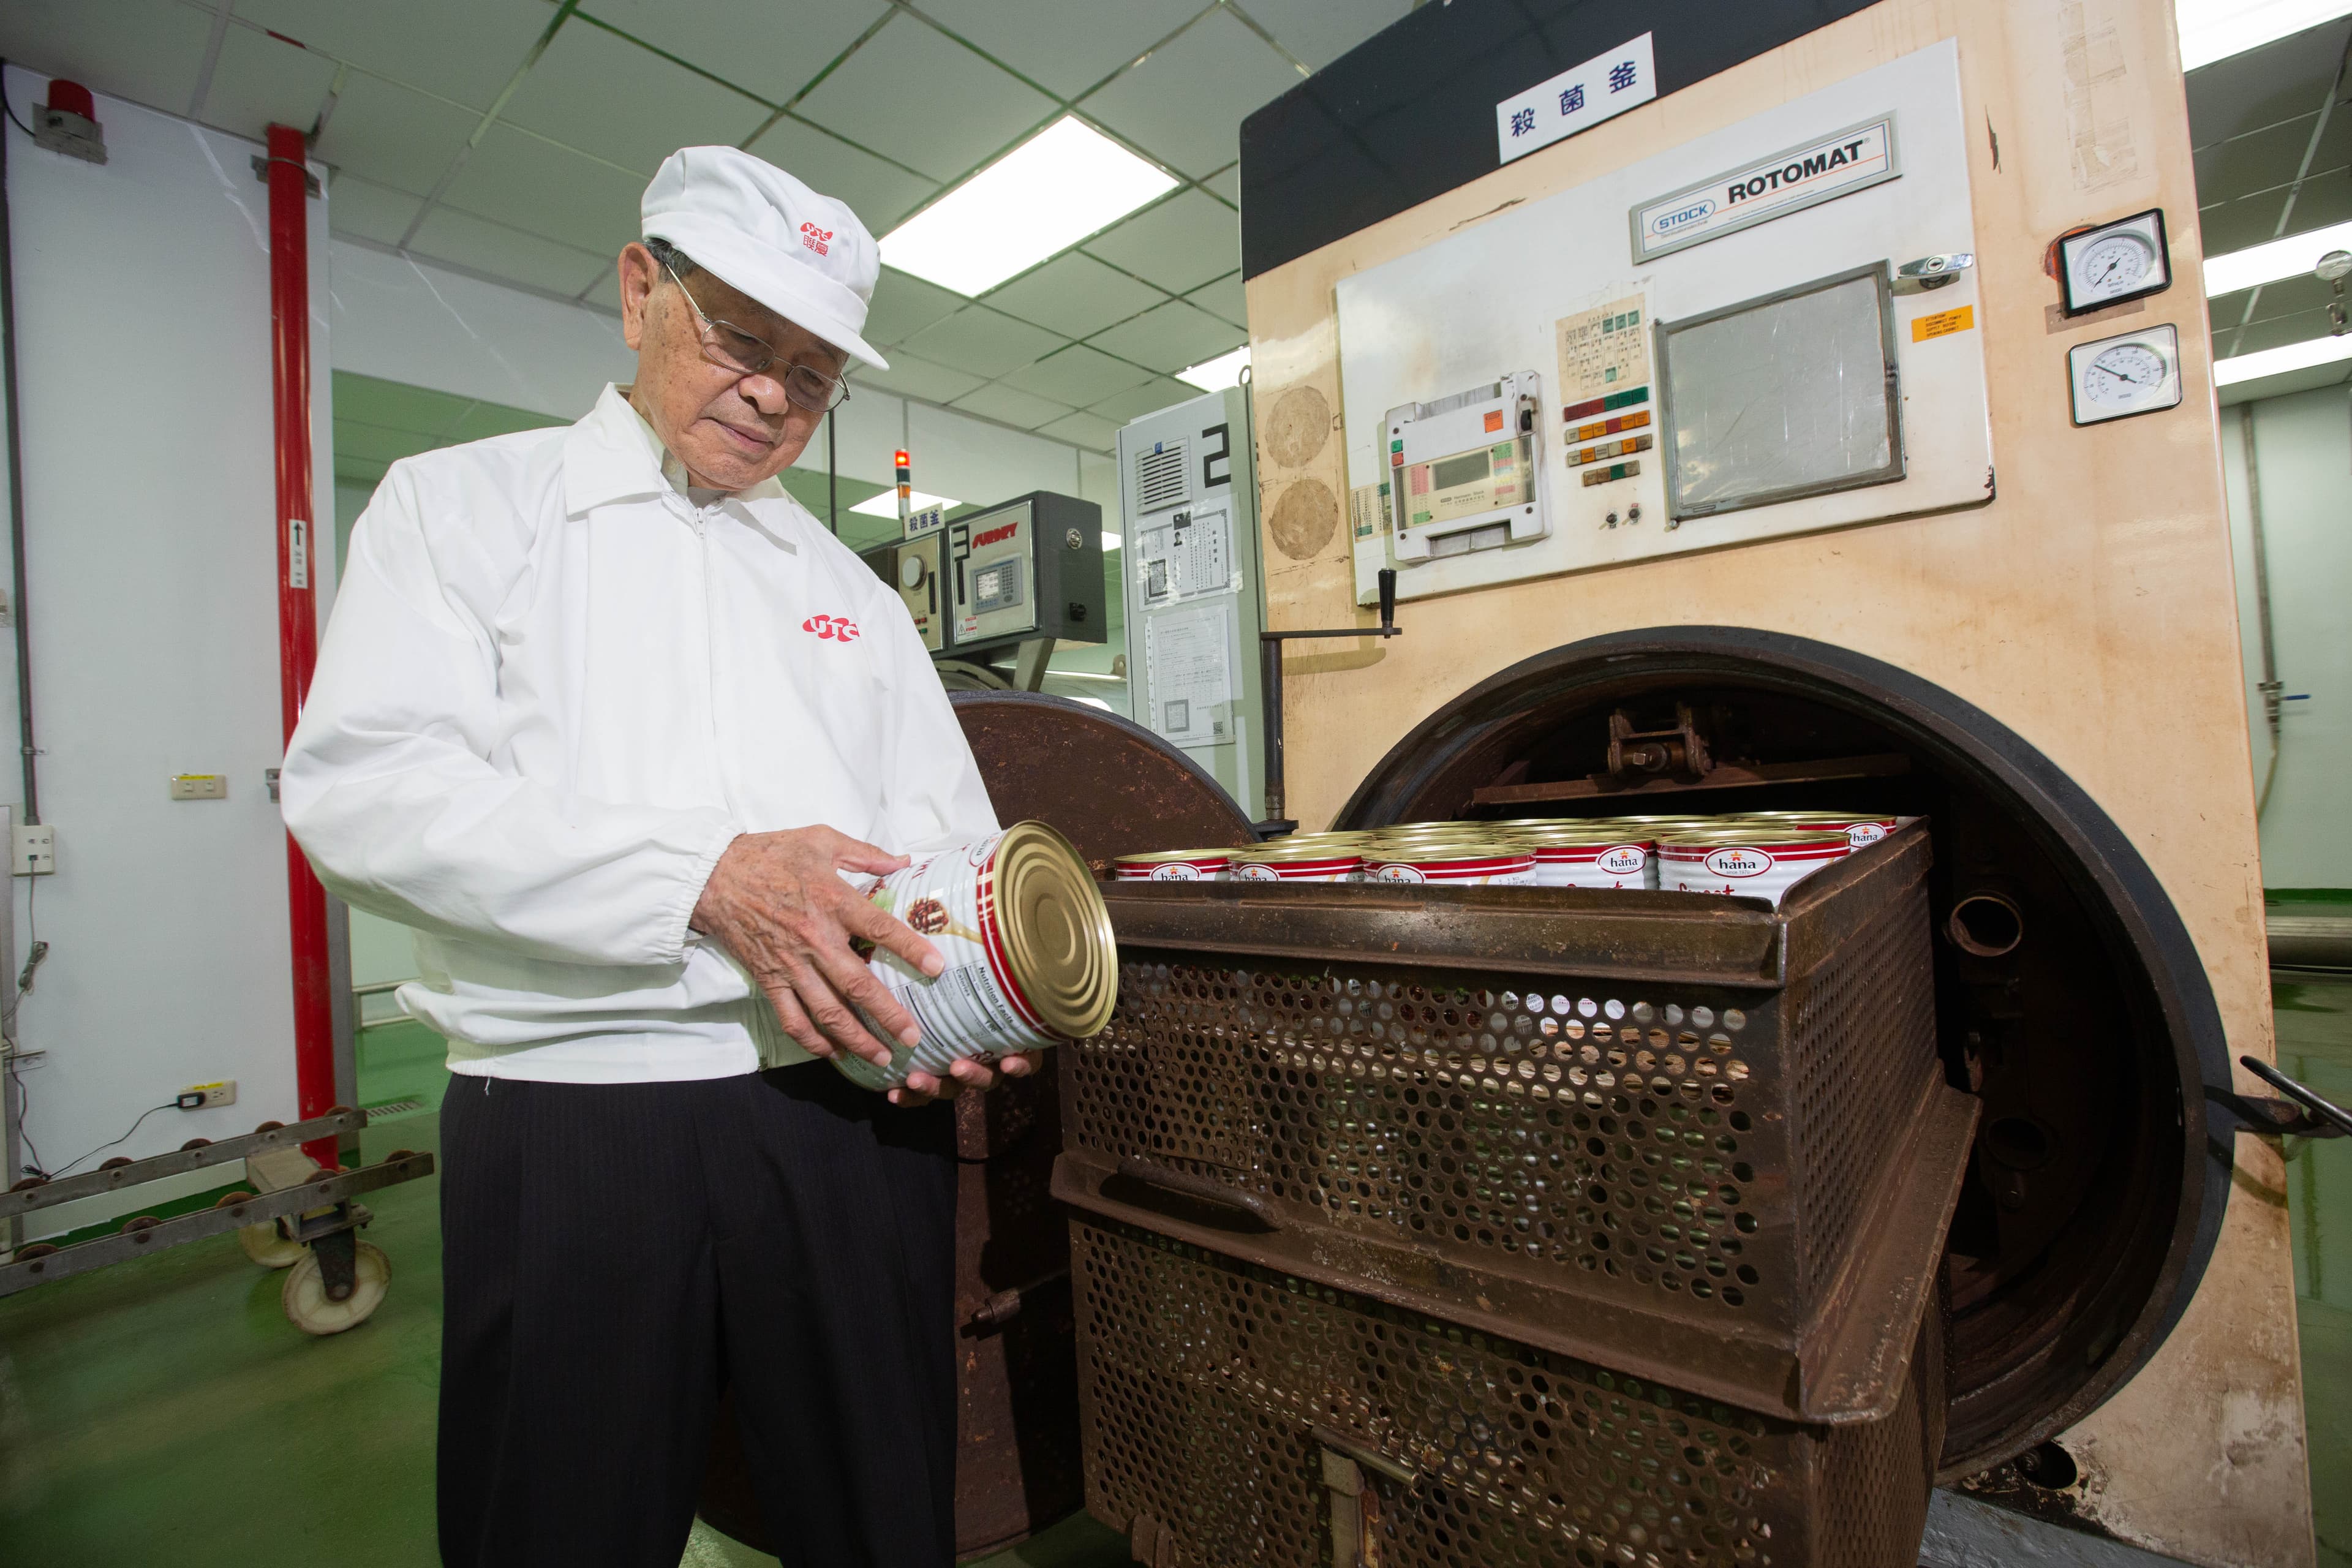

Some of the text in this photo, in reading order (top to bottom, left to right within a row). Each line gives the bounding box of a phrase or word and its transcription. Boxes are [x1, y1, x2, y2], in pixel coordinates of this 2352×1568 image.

[1511, 61, 1636, 137] 殺菌釜
[1659, 204, 1708, 230] STOCK
[1202, 422, 1231, 488] 2
[1853, 833, 1878, 842] hana
[1610, 858, 1638, 867] hana
[1719, 859, 1756, 869] hana
[956, 969, 971, 997] Calories
[979, 967, 999, 1003] Nutrition
[998, 1004, 1014, 1023] Facts
